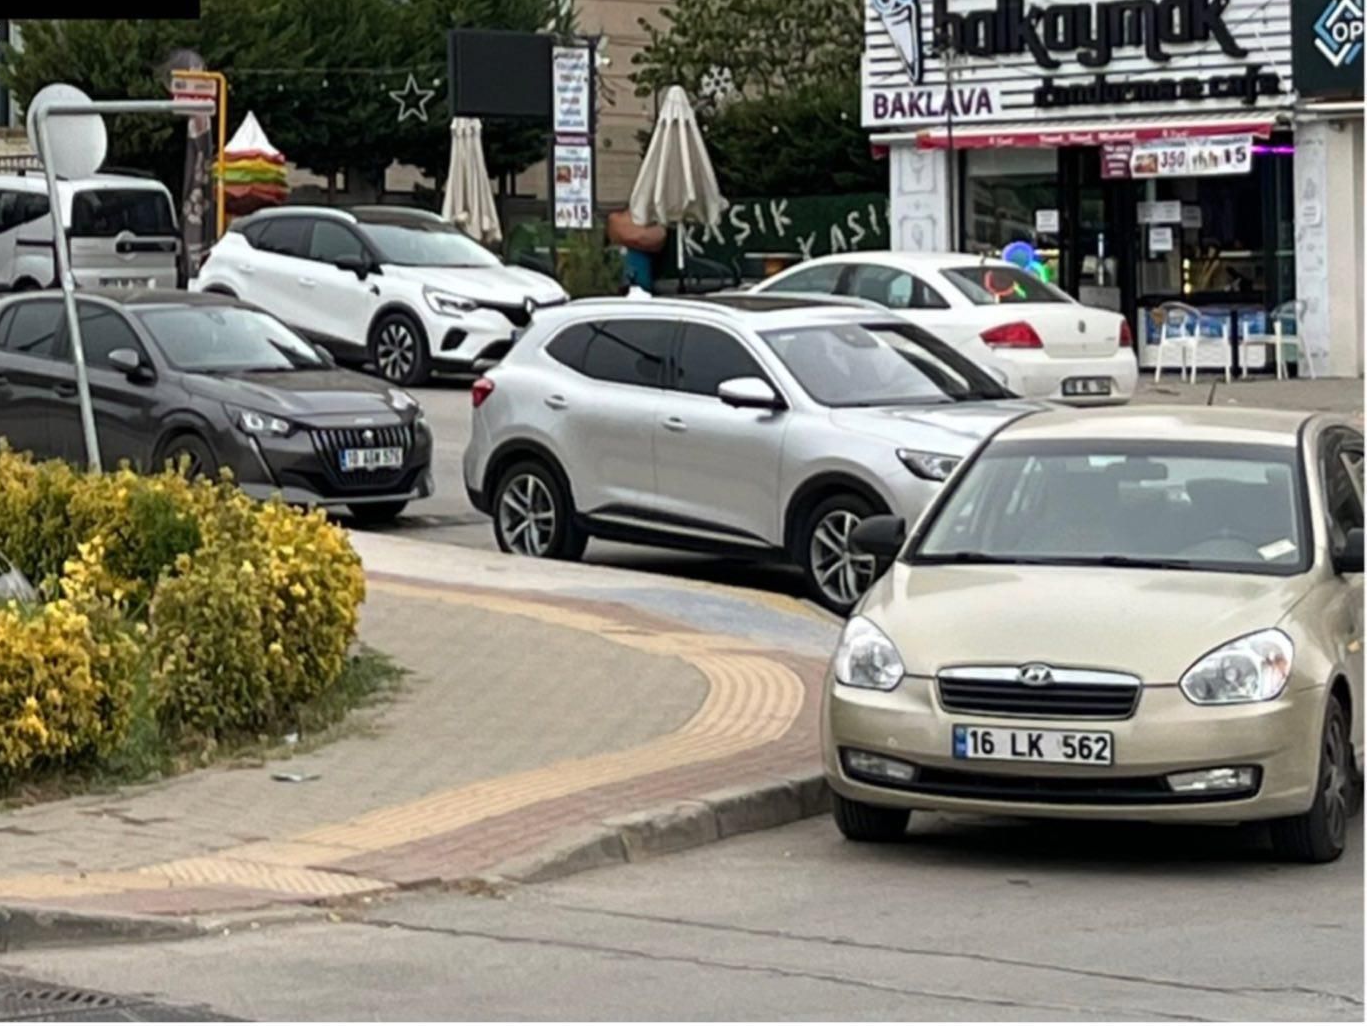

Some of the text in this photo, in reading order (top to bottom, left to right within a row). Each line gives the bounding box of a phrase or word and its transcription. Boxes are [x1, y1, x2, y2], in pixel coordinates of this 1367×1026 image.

[873, 88, 993, 119] BAKLAVA
[1160, 150, 1184, 169] 350
[796, 198, 891, 262] KAŞI
[970, 730, 1108, 761] 16 LK 562
